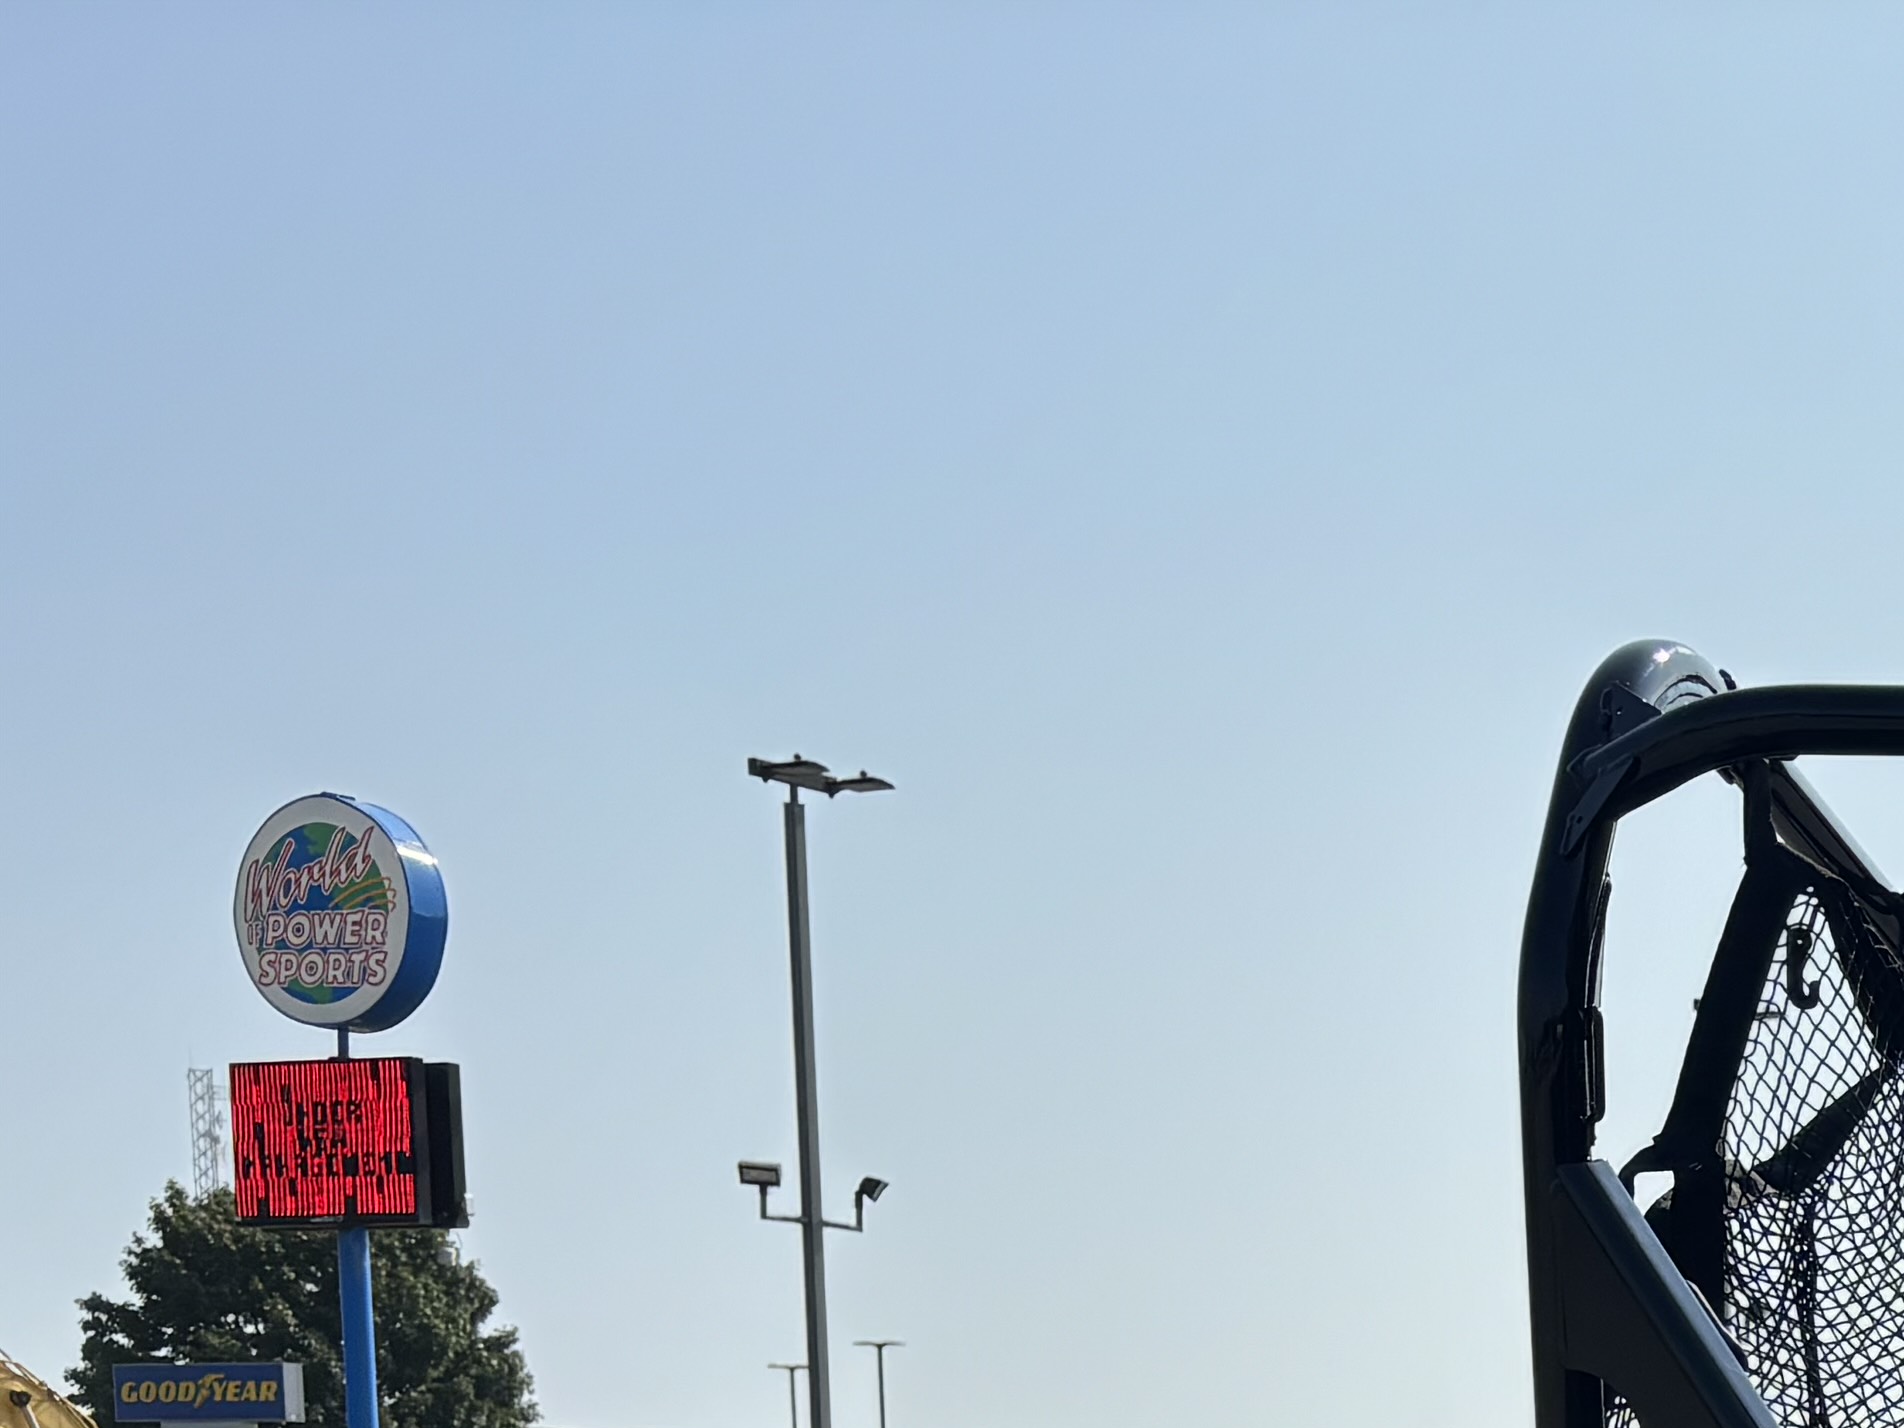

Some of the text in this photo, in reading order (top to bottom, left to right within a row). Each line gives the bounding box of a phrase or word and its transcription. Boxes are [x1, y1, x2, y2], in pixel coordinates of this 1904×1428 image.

[245, 825, 375, 922] World
[265, 910, 388, 948] POWER
[258, 950, 388, 988] SPORTS
[121, 1376, 278, 1406] GOODYEAR
